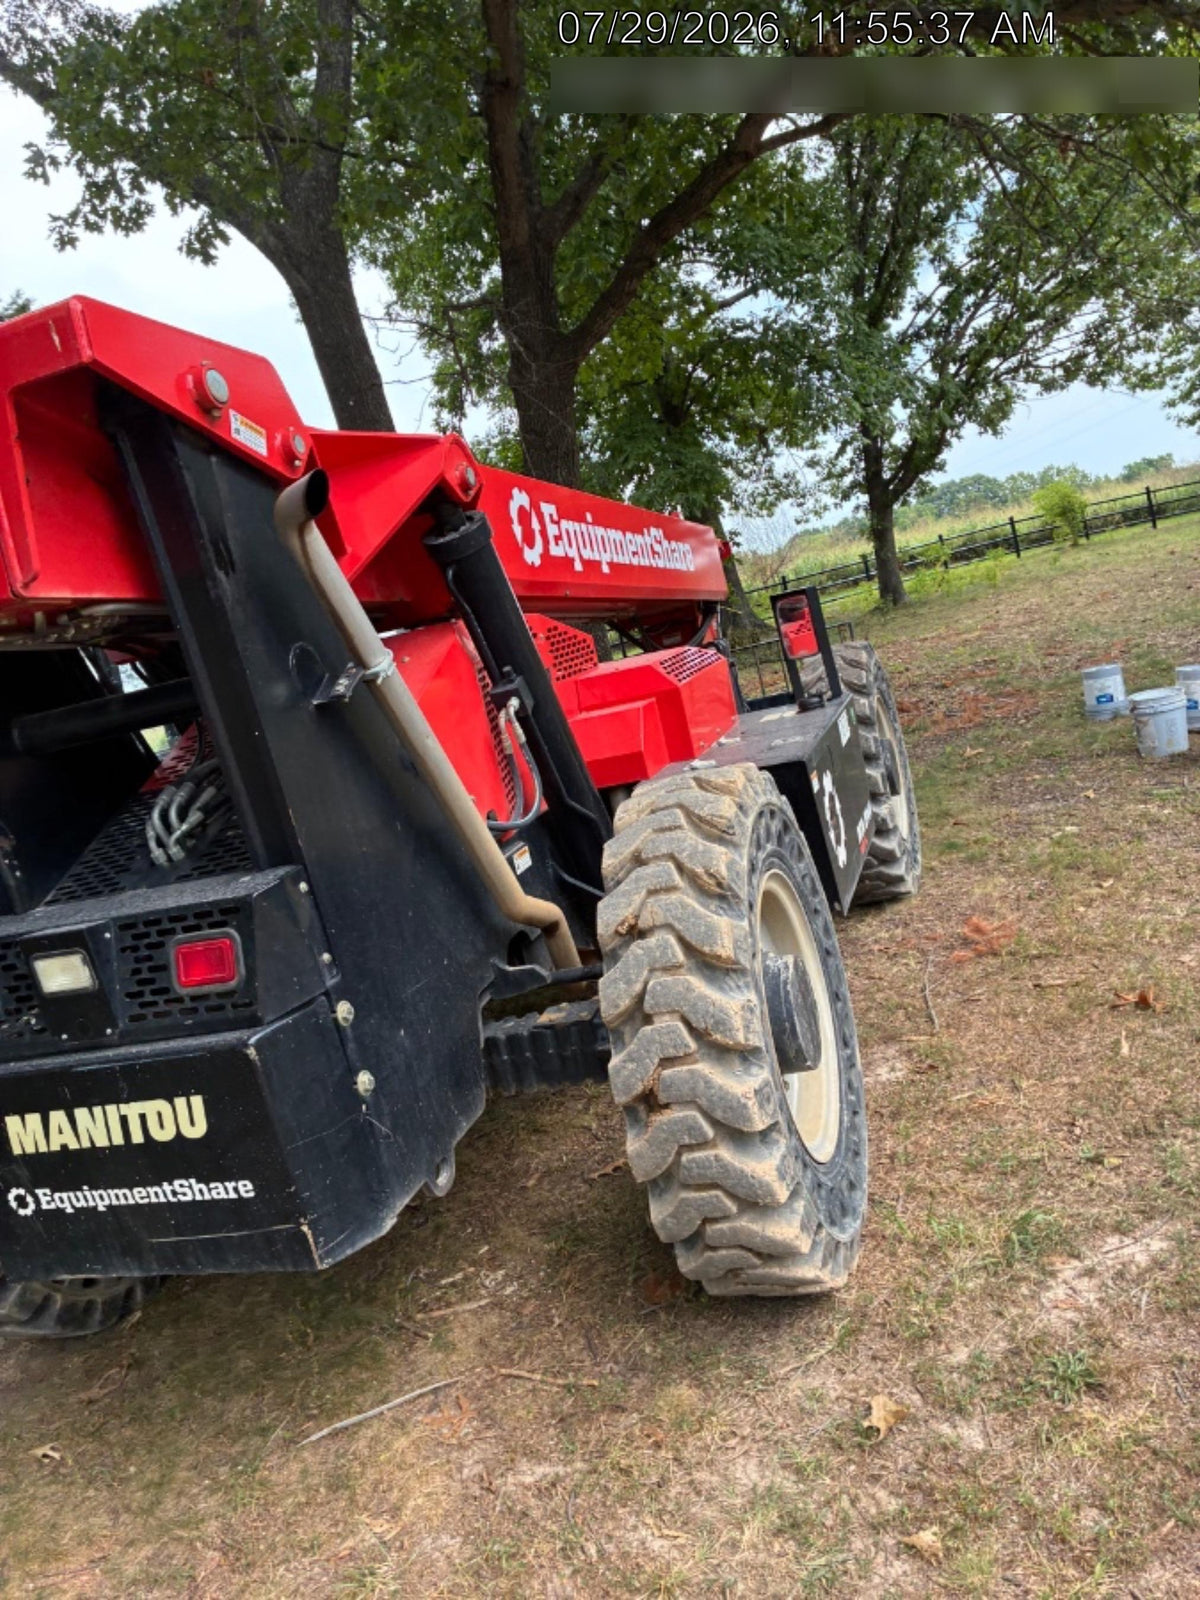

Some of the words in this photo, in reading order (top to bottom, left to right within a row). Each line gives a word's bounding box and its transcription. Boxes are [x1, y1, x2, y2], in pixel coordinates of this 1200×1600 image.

[539, 500, 696, 574] EquipmentShare
[4, 1094, 208, 1156] MANITOU
[35, 1177, 256, 1214] EquipmentShare
